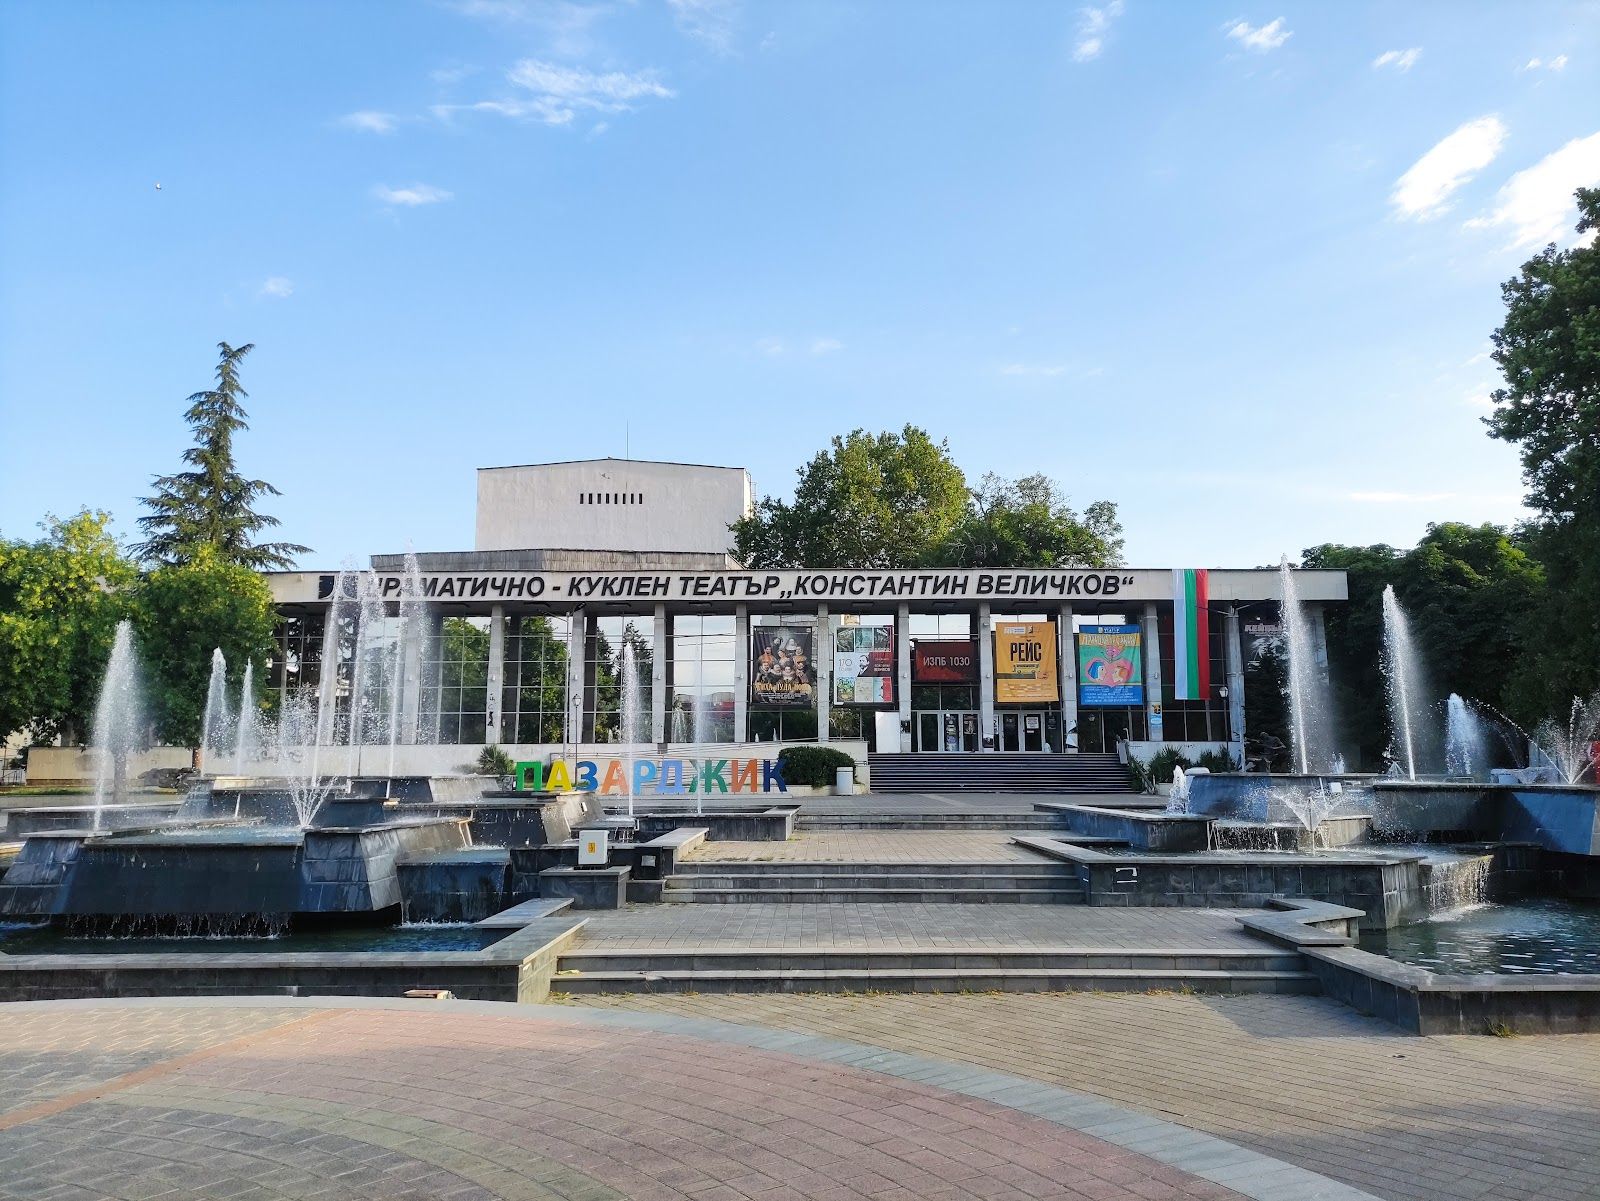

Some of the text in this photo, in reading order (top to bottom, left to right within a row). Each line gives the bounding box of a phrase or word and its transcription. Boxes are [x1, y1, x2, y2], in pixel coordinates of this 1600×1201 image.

[366, 576, 545, 597] РАМАТИЧНО
[568, 576, 671, 597] КУКЛЕН
[679, 576, 781, 596] ТЕАТЪР
[923, 656, 970, 666] ИЗПБ 1030
[1010, 639, 1042, 662] РЕЙС
[516, 760, 788, 796] ПАЗАРДЖИК
